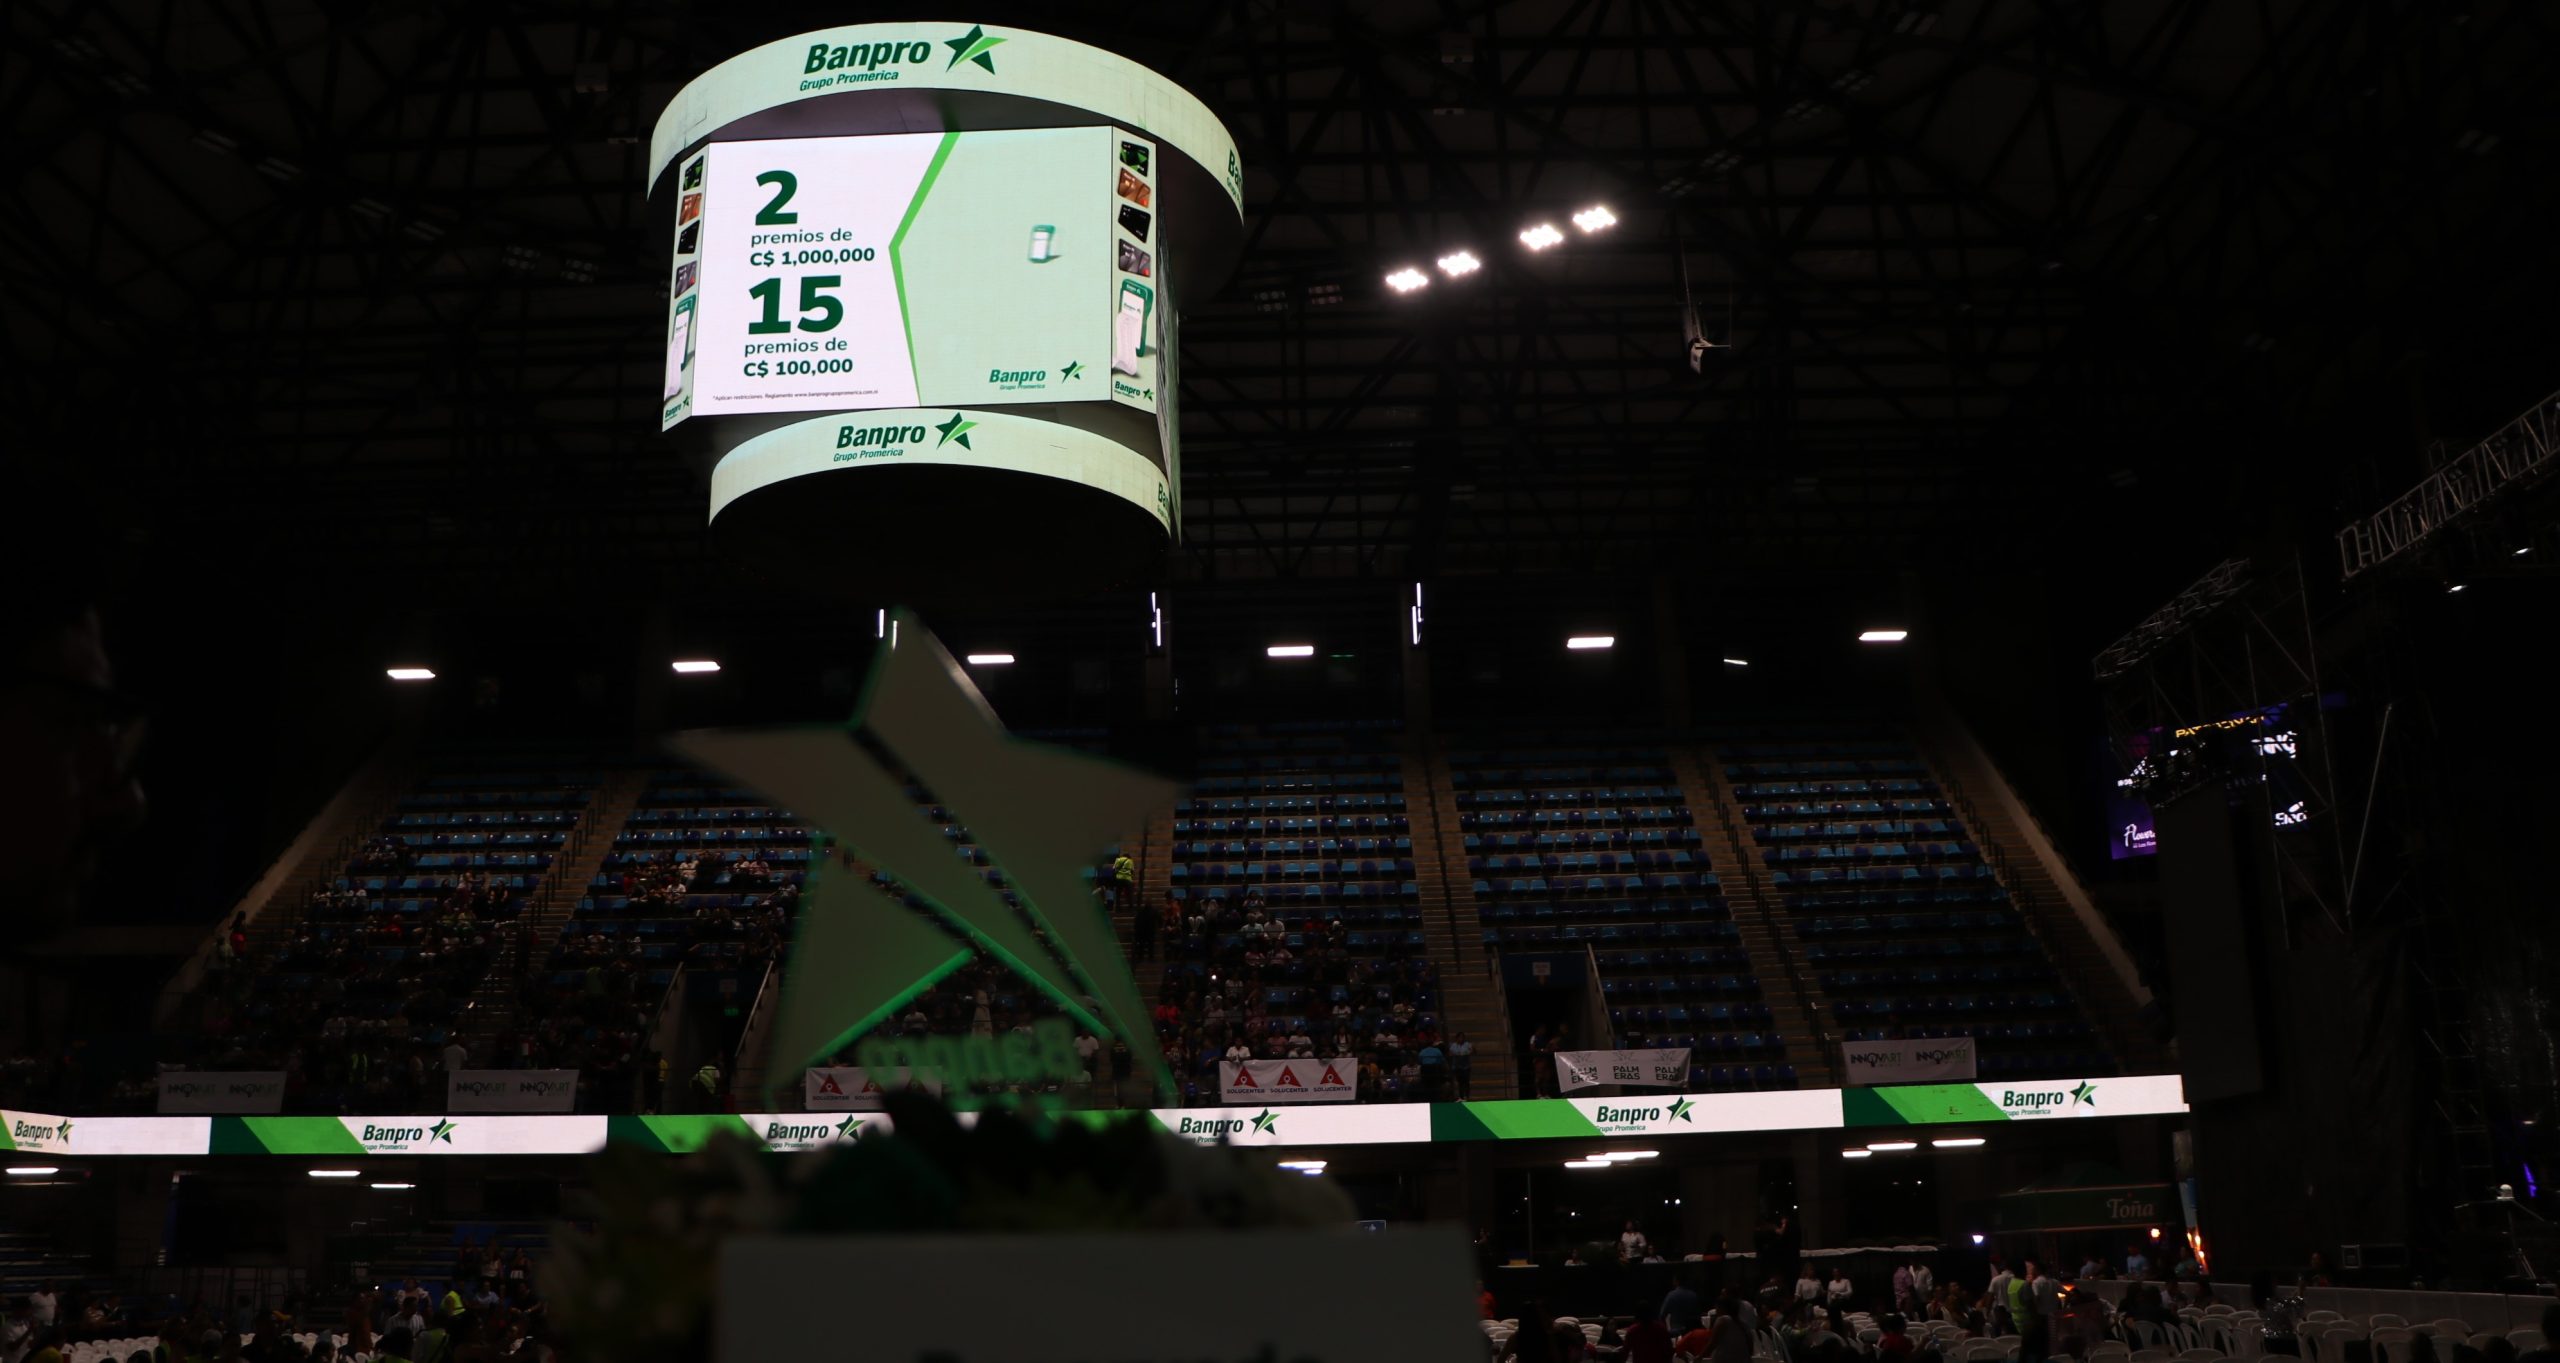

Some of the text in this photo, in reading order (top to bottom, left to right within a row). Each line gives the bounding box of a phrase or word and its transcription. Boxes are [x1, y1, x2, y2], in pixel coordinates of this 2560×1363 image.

[804, 41, 931, 75] Banpro
[800, 70, 900, 92] Grupo Promerica
[755, 170, 798, 226] 2
[751, 227, 853, 248] premios de
[750, 247, 875, 267] C$ 1,000,000
[748, 275, 844, 335] 15
[744, 337, 848, 357] premios de
[743, 358, 853, 378] C$ 100,000
[989, 368, 1047, 385] Banpro
[1114, 380, 1141, 396] Banpro
[836, 425, 926, 449] Banpro
[833, 448, 903, 462] Grupo Promerica
[1613, 1065, 1639, 1073] PALM
[1655, 1066, 1681, 1074] PALM
[2003, 1090, 2064, 1109] Banpro
[1597, 1106, 1660, 1125] Banpro
[15, 1120, 53, 1141] Banpro
[363, 1124, 423, 1144] Banpro
[768, 1122, 829, 1142] Banpro
[1180, 1117, 1244, 1137] Banpro
[2105, 1198, 2155, 1218] Toña
